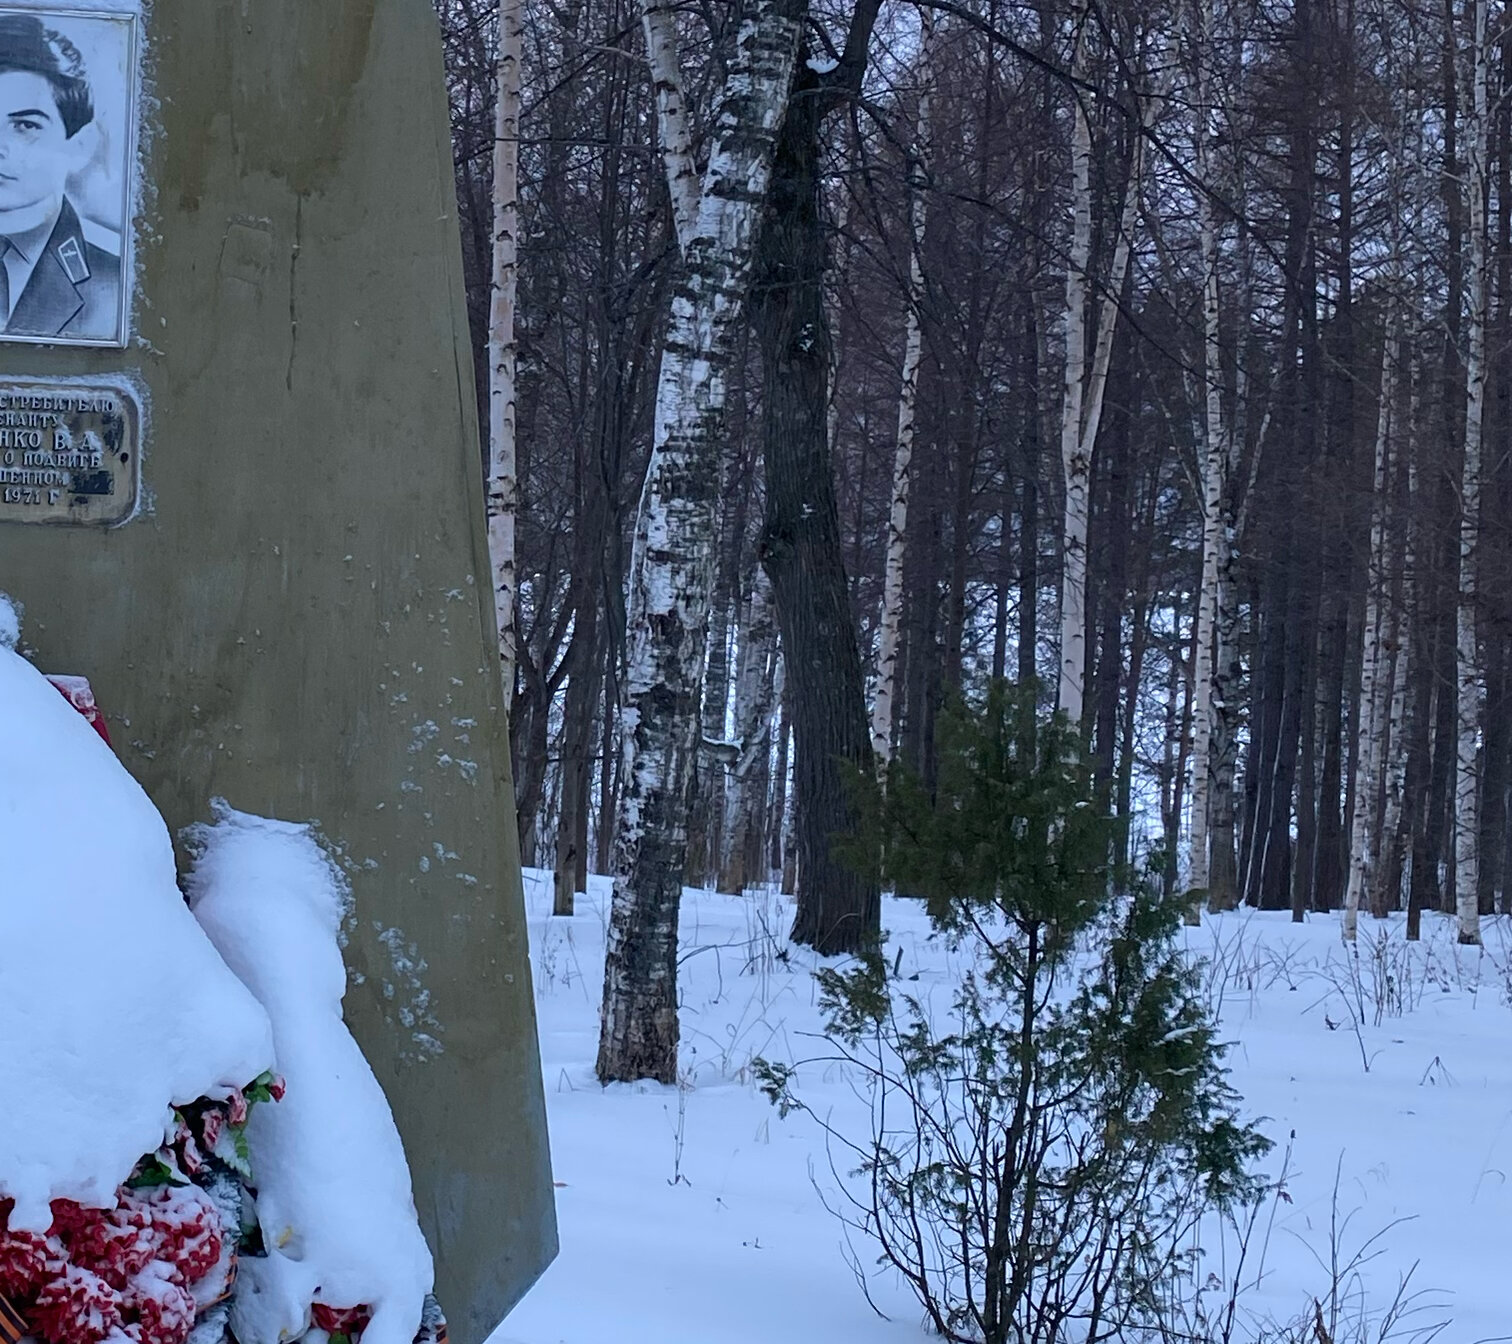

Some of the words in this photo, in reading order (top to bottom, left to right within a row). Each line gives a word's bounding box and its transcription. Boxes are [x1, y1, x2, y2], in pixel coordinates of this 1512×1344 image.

[4, 449, 15, 464] О
[23, 451, 103, 469] ПОДВИГЕ
[4, 488, 40, 504] 1971
